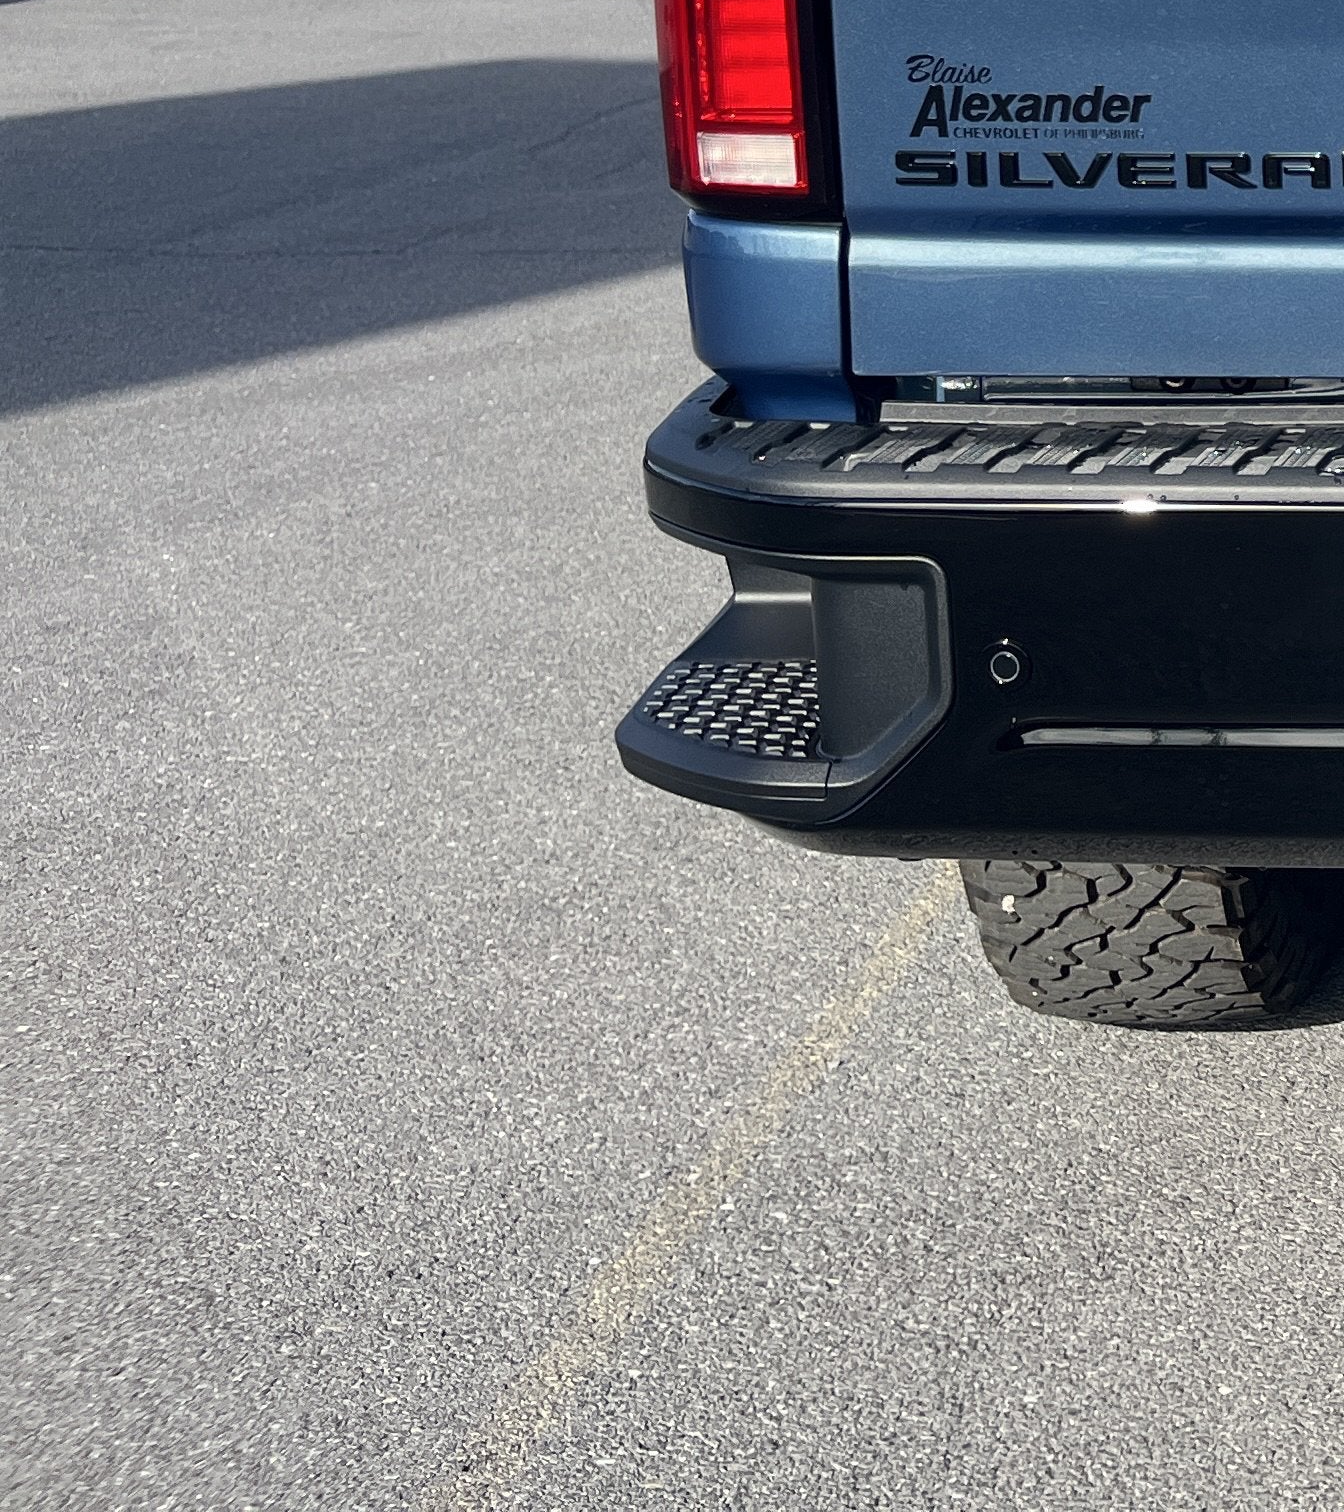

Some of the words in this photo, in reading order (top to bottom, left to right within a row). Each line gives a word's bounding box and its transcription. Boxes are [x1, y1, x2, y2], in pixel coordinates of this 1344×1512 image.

[905, 54, 993, 85] Blaise
[909, 84, 1153, 139] Alexander
[953, 126, 1040, 139] CHEVROLET
